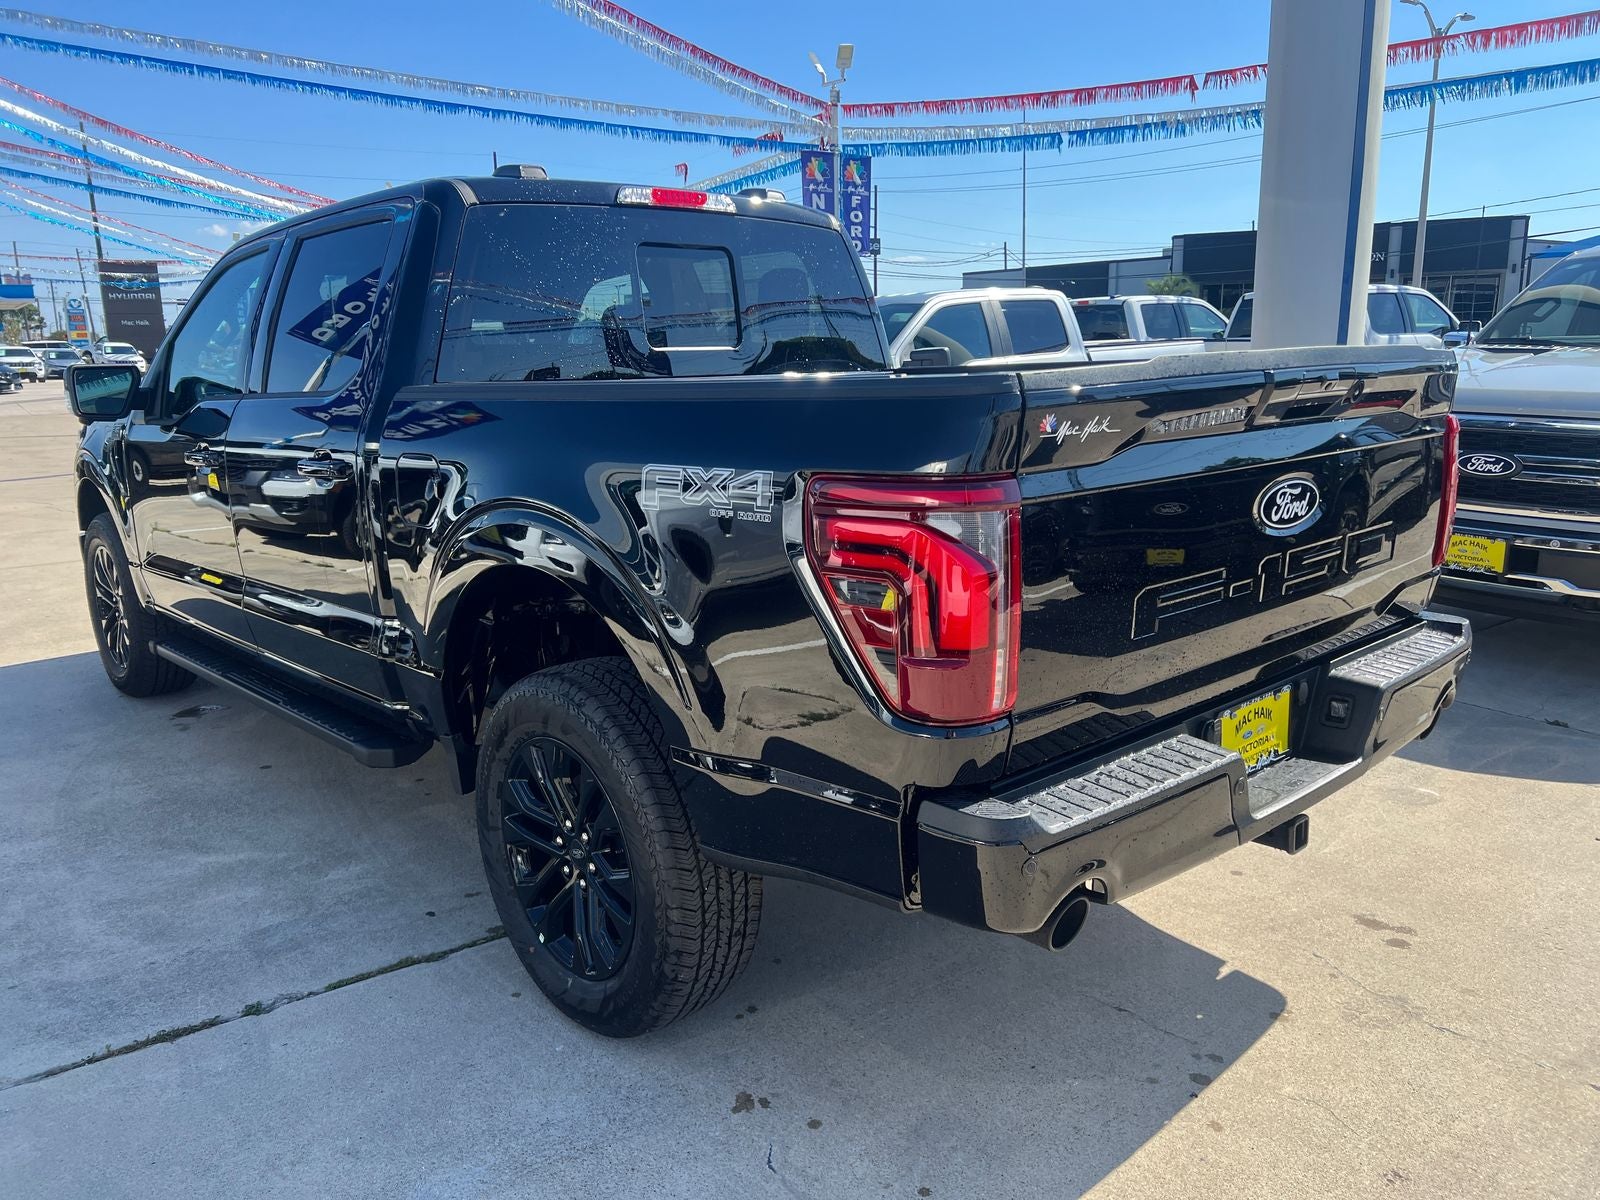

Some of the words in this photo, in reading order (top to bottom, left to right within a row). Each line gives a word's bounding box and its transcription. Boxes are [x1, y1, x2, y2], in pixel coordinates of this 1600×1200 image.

[849, 195, 863, 252] FORD
[108, 292, 156, 300] HYUNDAI
[1042, 420, 1081, 445] Mac
[1080, 415, 1121, 443] Haik
[1467, 456, 1504, 473] Ford
[641, 463, 775, 513] FX4
[709, 508, 734, 519] OFF
[737, 511, 772, 523] ROAD
[1271, 487, 1311, 523] Ford
[1451, 539, 1468, 548] MAC
[1469, 540, 1489, 553] HAIK
[1453, 553, 1484, 563] VICTORIA
[1131, 520, 1397, 641] F-150
[1235, 710, 1252, 736] MAC
[1253, 706, 1273, 722] HAIK
[1238, 735, 1270, 755] VICTORIA
